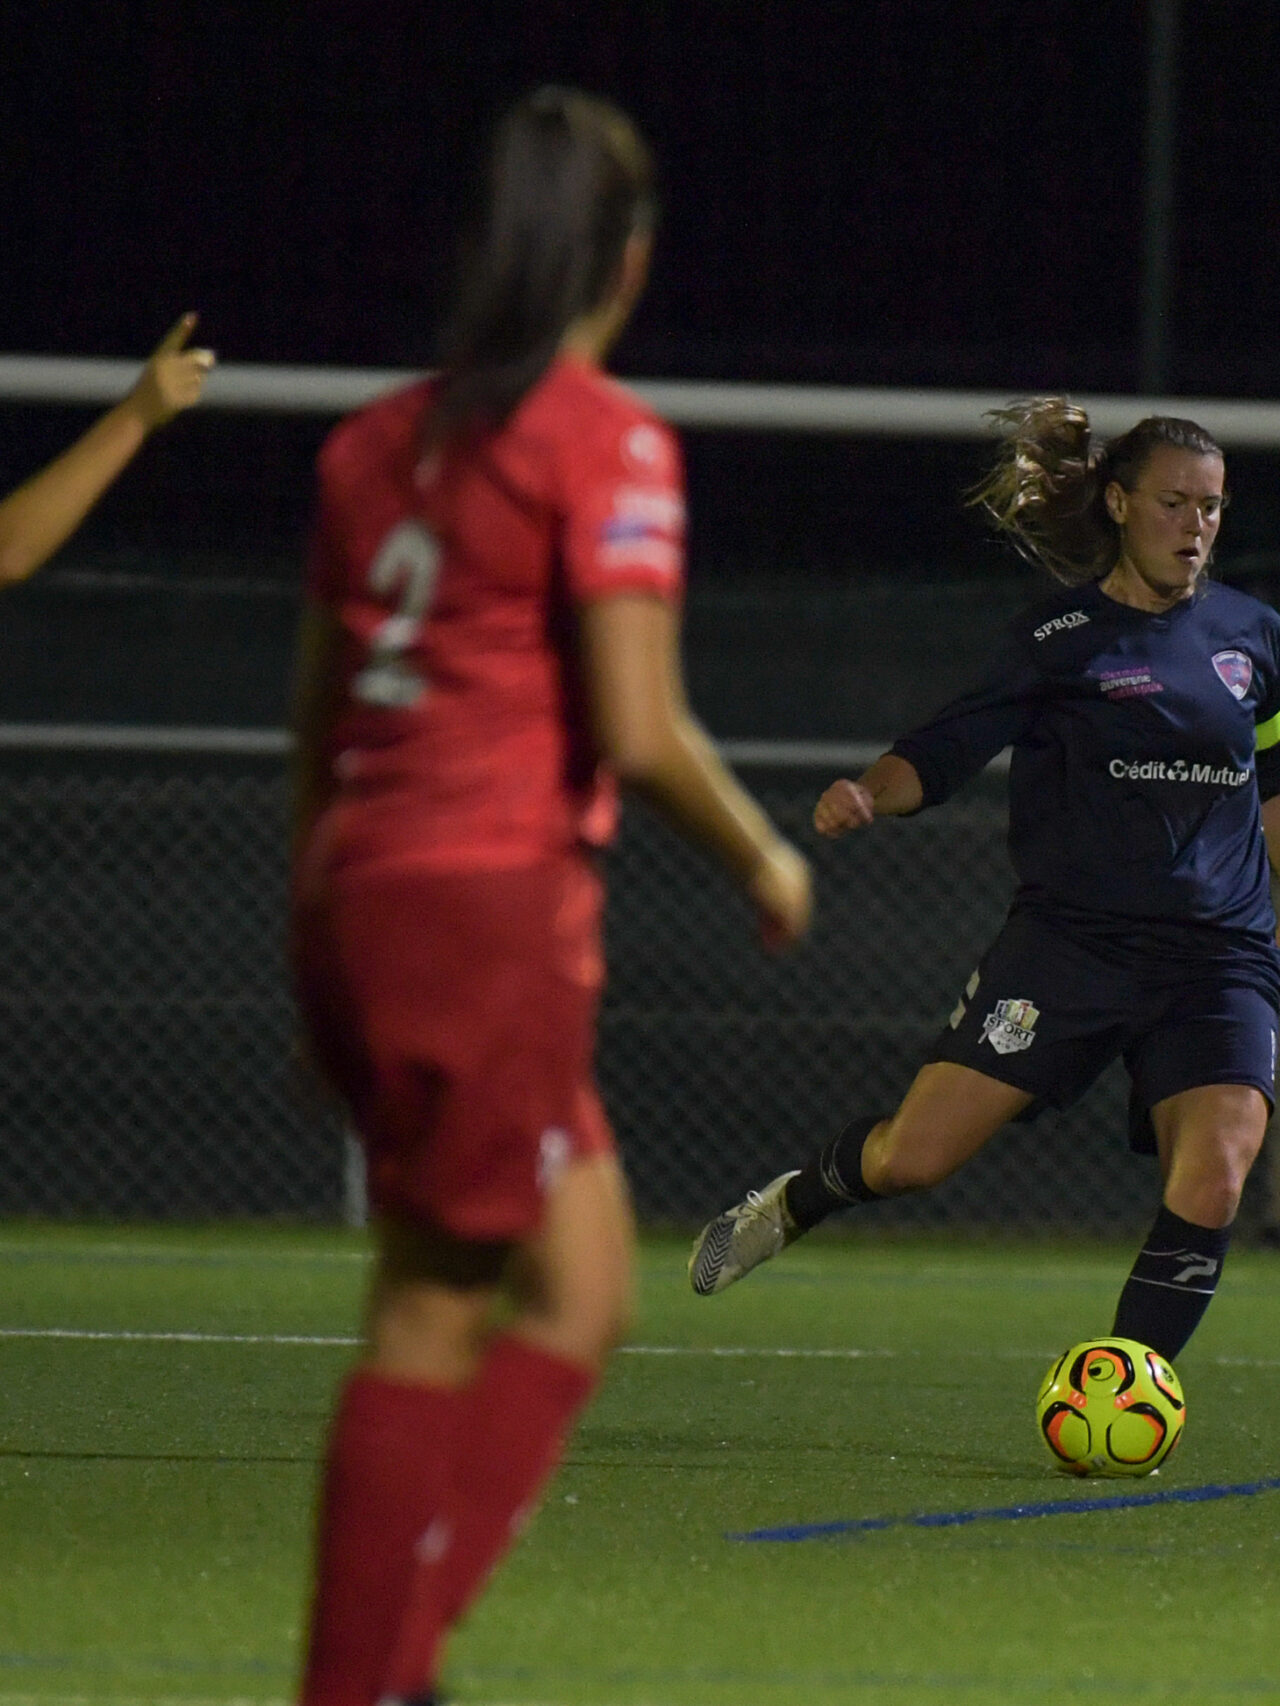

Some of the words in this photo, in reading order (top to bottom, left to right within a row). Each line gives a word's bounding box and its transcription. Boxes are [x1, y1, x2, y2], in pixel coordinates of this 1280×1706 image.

[355, 521, 442, 706] 2
[1034, 611, 1090, 641] SPROX
[1109, 759, 1166, 780] Crédit
